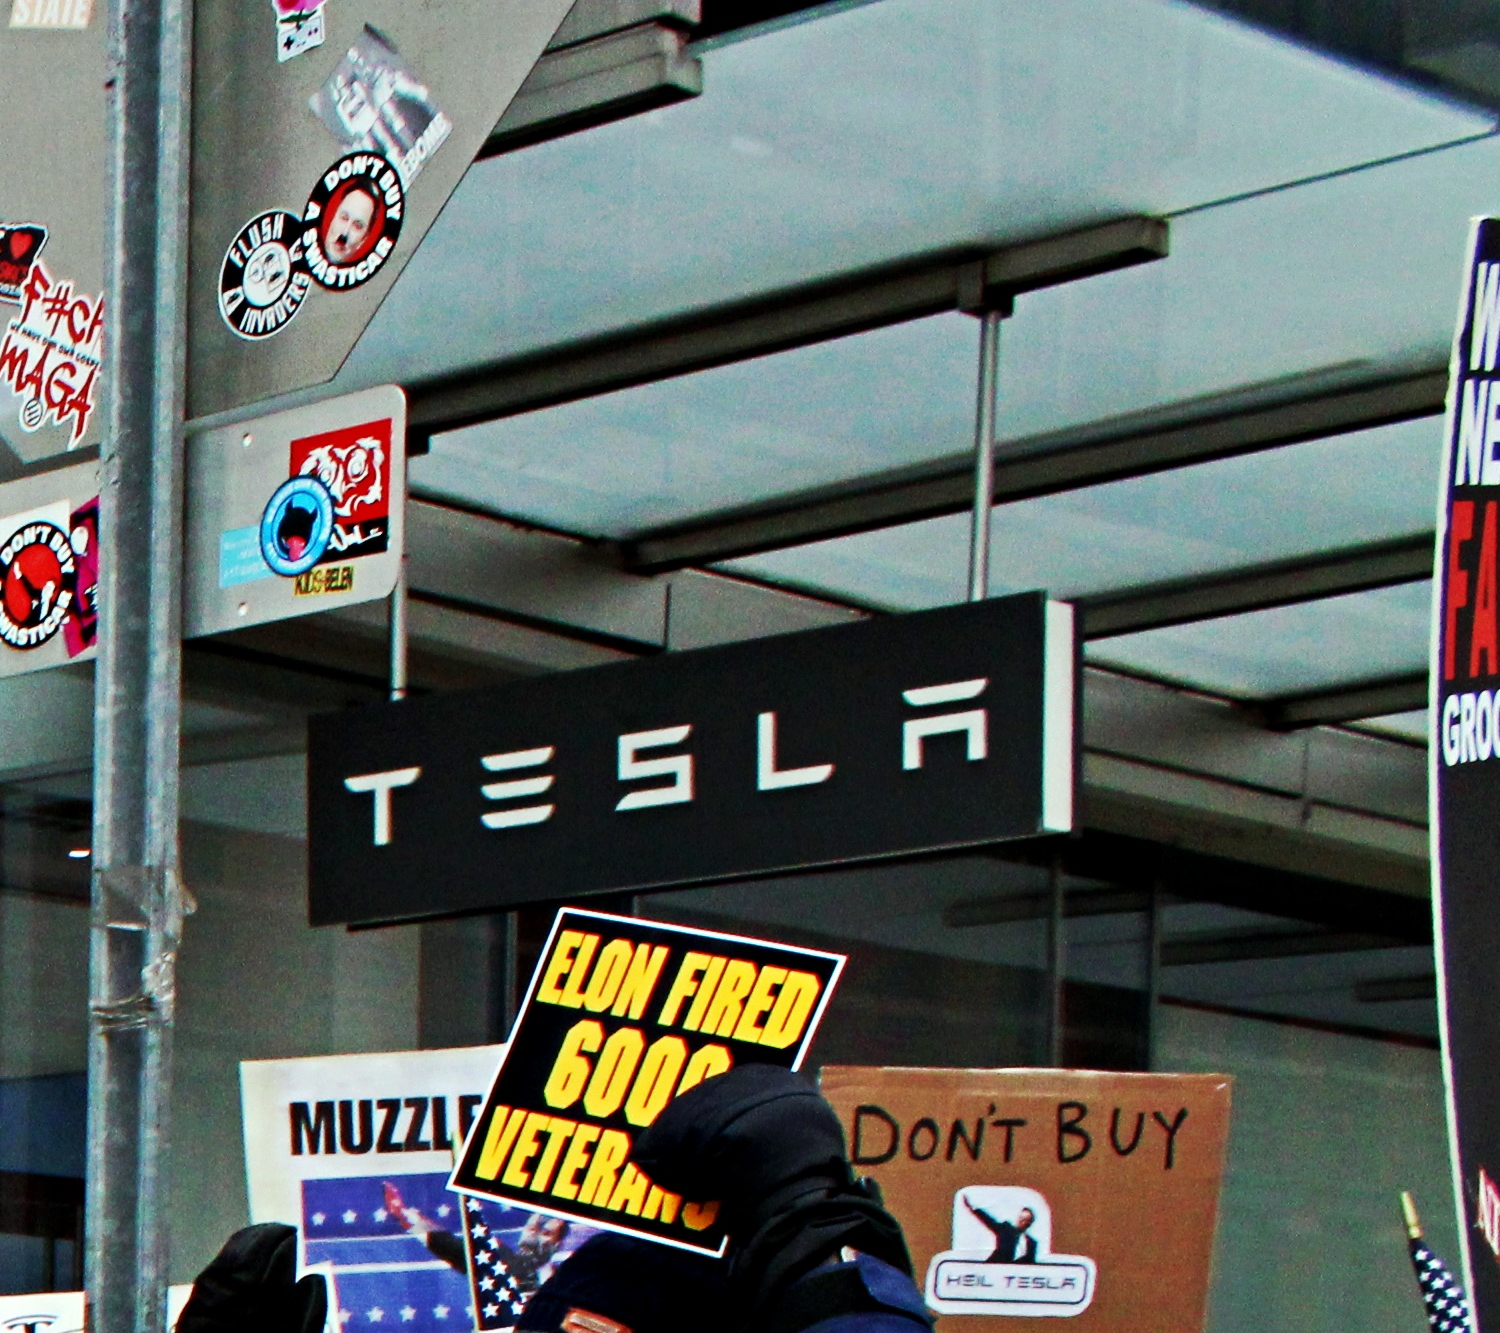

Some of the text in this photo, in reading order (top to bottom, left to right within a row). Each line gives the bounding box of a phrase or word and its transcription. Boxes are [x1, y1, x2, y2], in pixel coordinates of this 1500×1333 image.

[324, 154, 404, 220] DON'T BUY
[229, 213, 284, 268] FLUSH
[302, 227, 393, 288] SWASTICAR
[239, 271, 311, 333] INVADERS
[0, 525, 75, 573] DON'T BUY
[344, 678, 989, 846] TESLA
[536, 929, 821, 1049] ELON FIRED
[852, 1100, 1190, 1170] DON'T BUY
[946, 1274, 1076, 1289] HEIL TESLA
